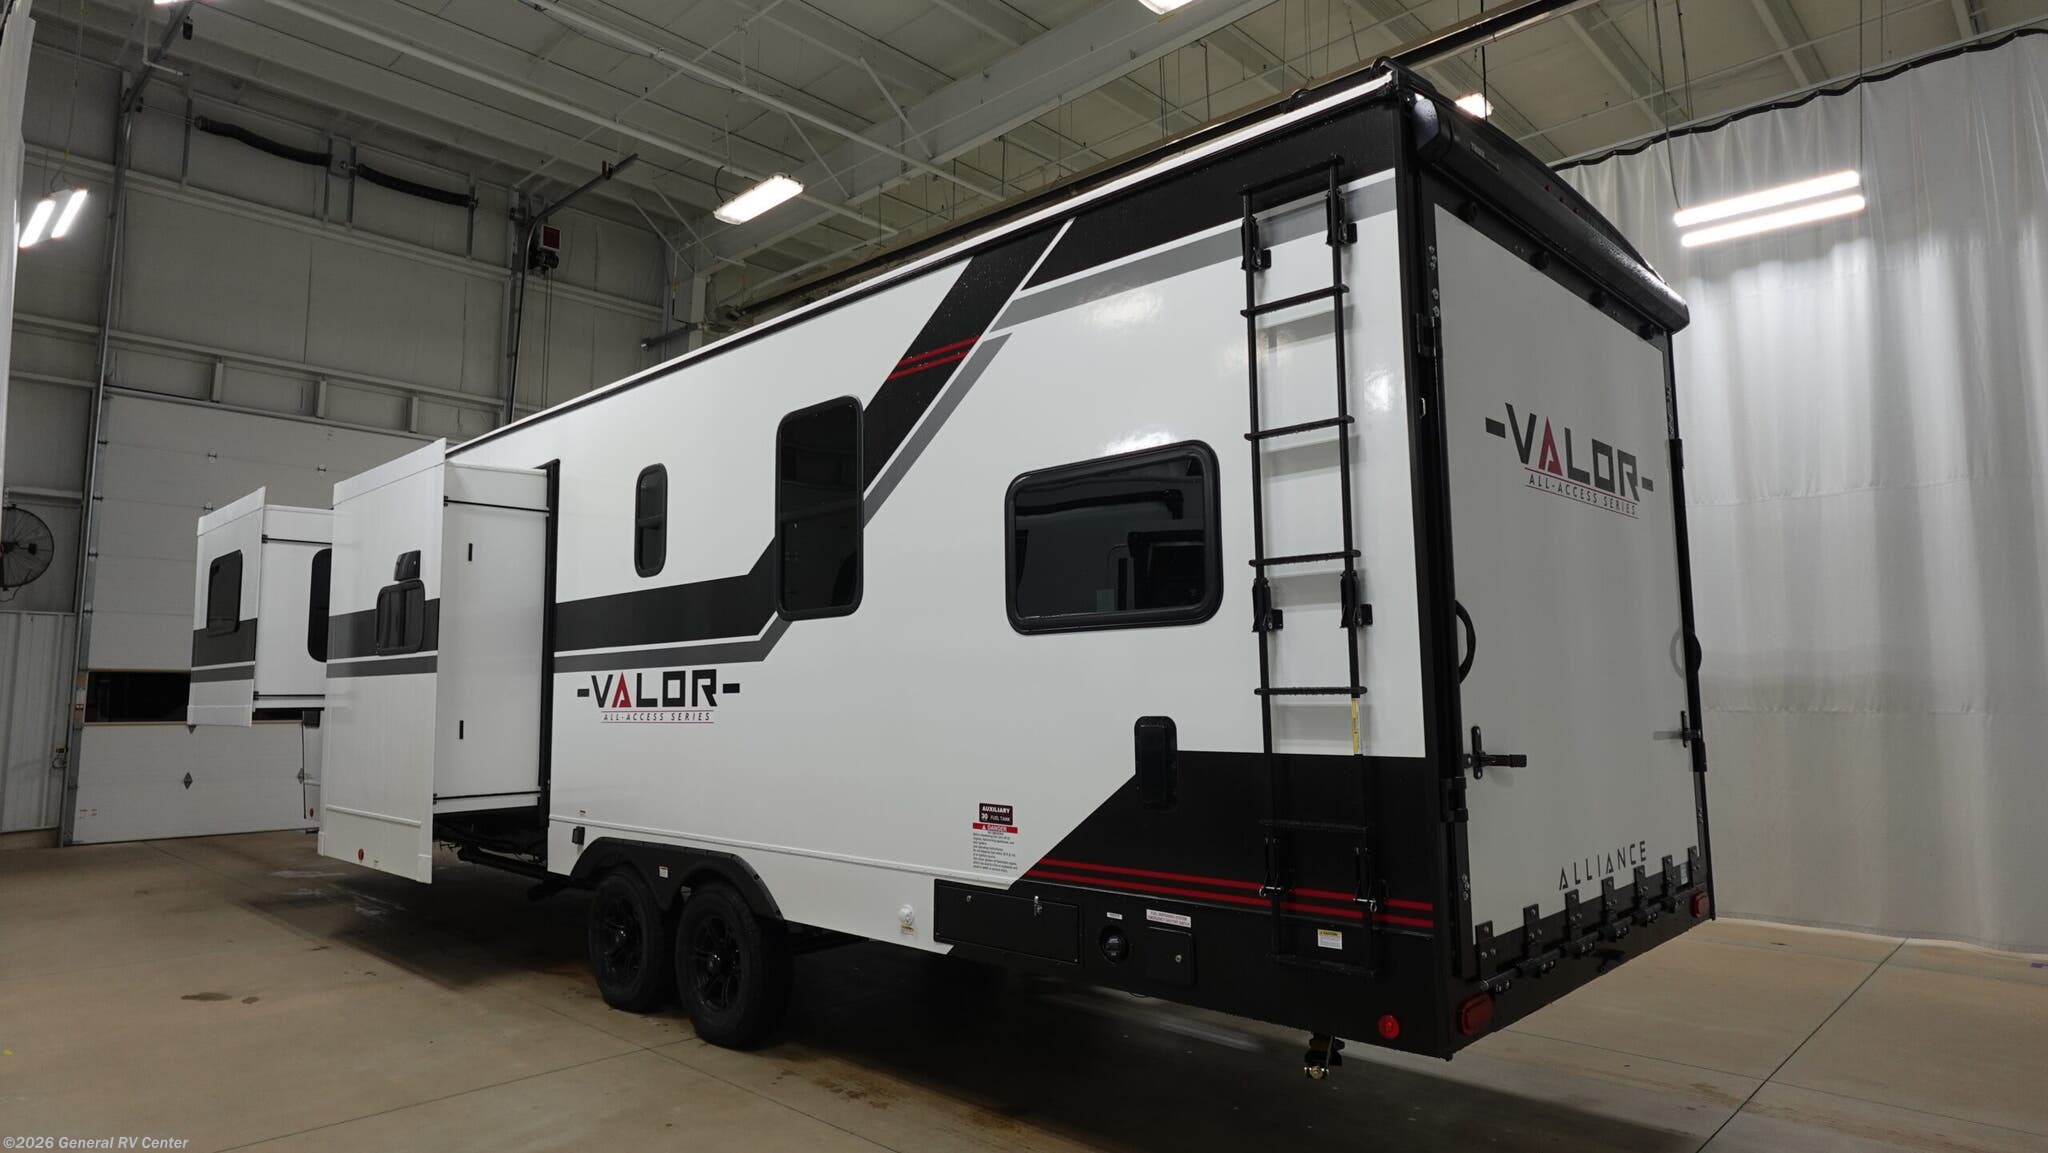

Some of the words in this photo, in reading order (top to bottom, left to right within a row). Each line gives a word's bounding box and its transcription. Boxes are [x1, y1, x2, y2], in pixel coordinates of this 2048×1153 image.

[1528, 473, 1598, 504] ALL-ACCESS
[1603, 496, 1636, 516] SERIES
[603, 712, 664, 721] ALL-ACCESS
[671, 712, 711, 721] SERIES
[981, 805, 1010, 814] AUXILIARY
[1559, 840, 1647, 891] ALLIANCE
